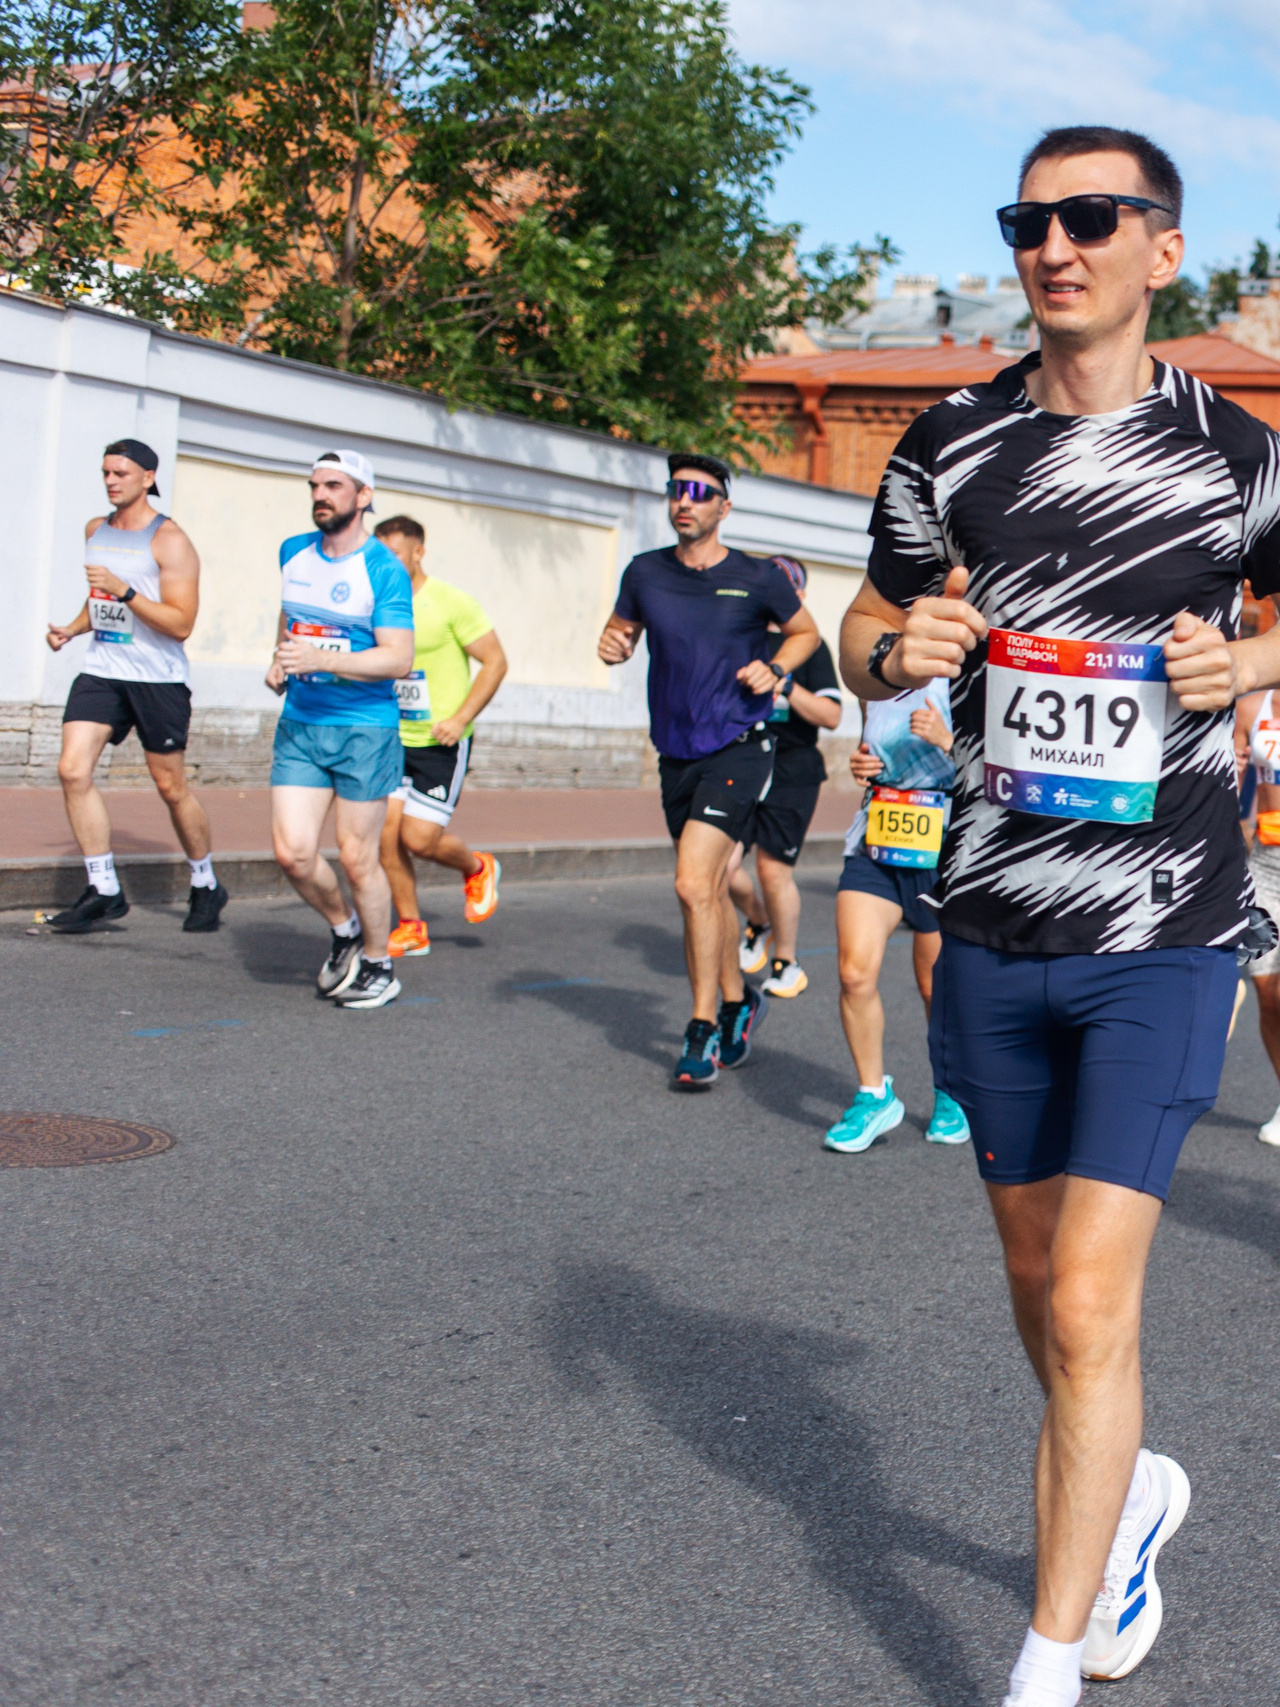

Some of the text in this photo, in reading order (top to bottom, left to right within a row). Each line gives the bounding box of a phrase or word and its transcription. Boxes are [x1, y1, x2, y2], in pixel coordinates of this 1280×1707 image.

[94, 603, 126, 623] 1544
[1006, 635, 1034, 649] ПОЛУ
[1006, 646, 1059, 663] МАРАФОН
[1085, 652, 1113, 669] 21,1
[1003, 686, 1139, 748] 4319
[1030, 746, 1105, 768] МИХАИЛ
[877, 809, 930, 836] 1550
